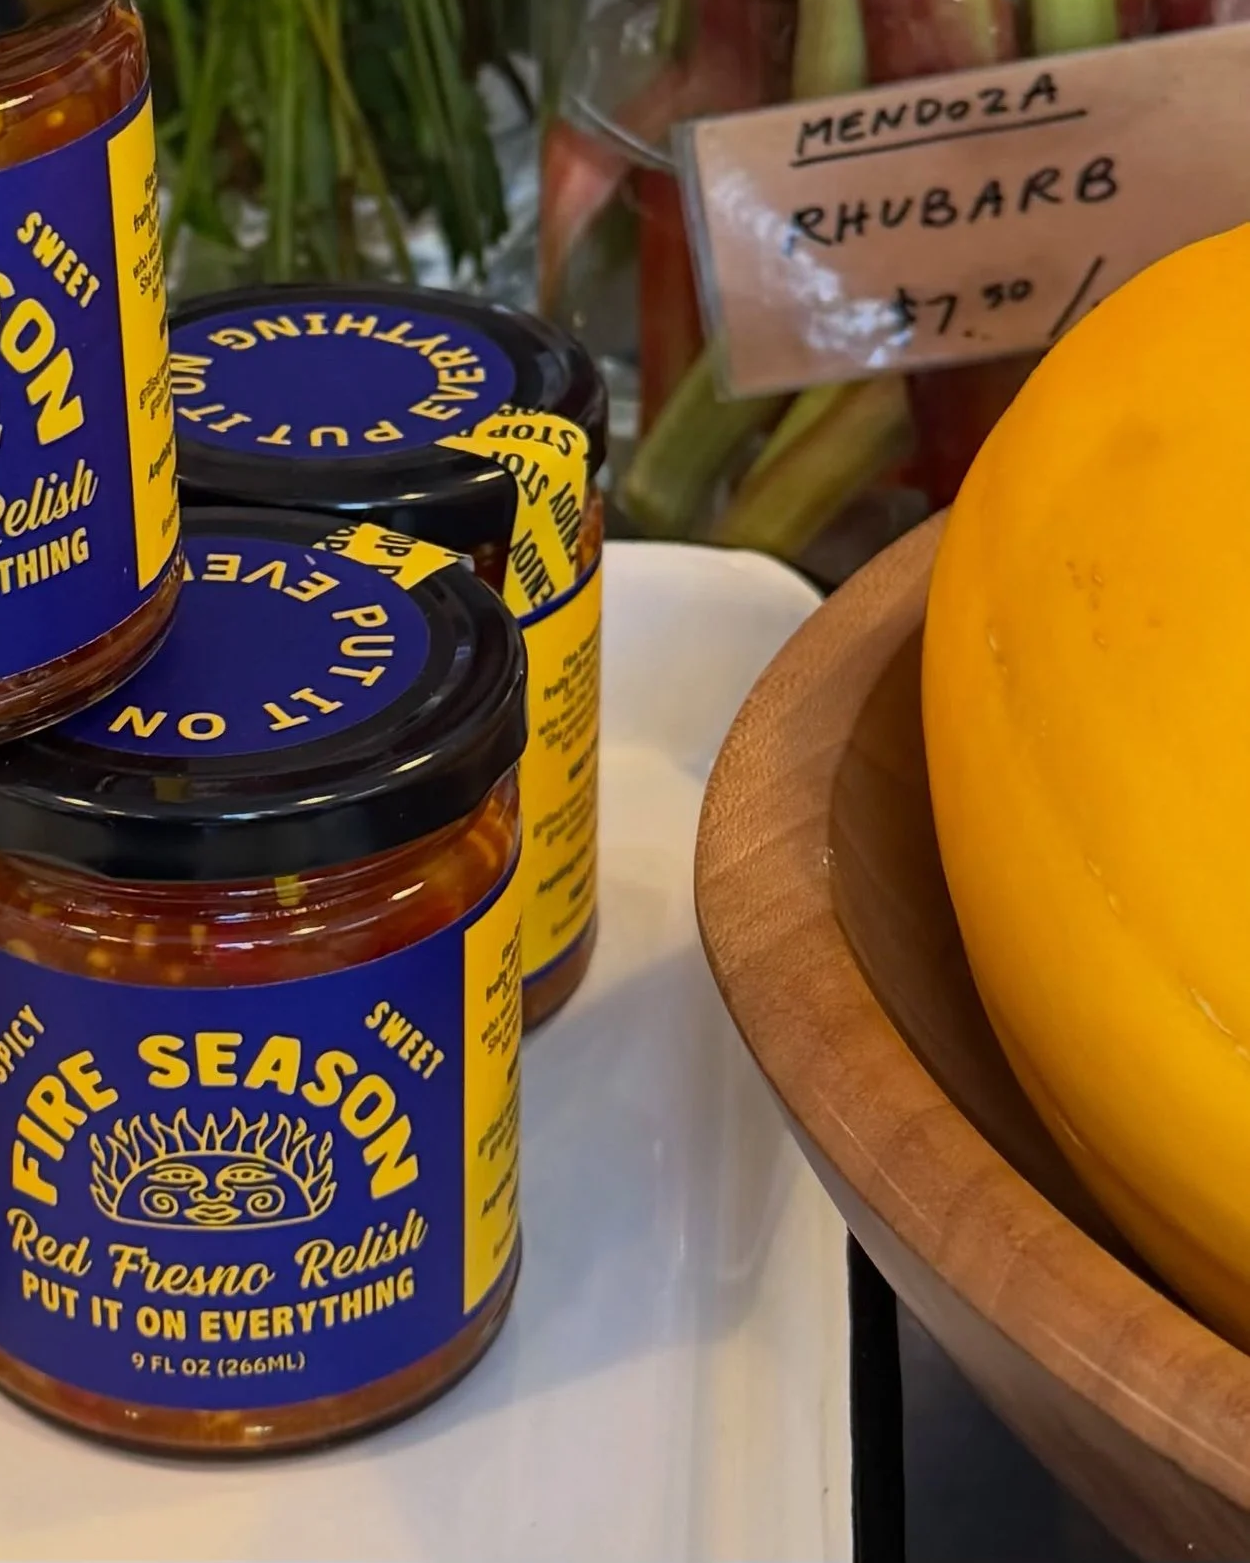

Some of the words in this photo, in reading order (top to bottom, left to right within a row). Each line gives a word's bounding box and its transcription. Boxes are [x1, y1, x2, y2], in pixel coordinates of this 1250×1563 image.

[783, 155, 1120, 258] RHUBARB
[16, 210, 101, 308] SWEET
[207, 312, 488, 422] EVERYTHING
[177, 402, 253, 434] IT
[256, 420, 405, 448] PUT
[330, 604, 397, 688] PUT
[107, 704, 228, 742] ON
[261, 685, 345, 734] IT
[363, 999, 447, 1080] SWEET
[11, 1049, 120, 1207] FIRE
[136, 1031, 421, 1200] SEASON
[6, 1207, 92, 1277] Red
[107, 1241, 276, 1297] Fresno
[292, 1207, 429, 1289] Relish
[21, 1268, 80, 1319] PUT
[90, 1297, 124, 1332] IT
[136, 1307, 187, 1340] ON
[200, 1266, 416, 1343] EVERYTHING
[131, 1352, 145, 1372] 9
[150, 1354, 176, 1376] FL
[181, 1355, 211, 1377] OZ
[217, 1350, 307, 1378] (266ML)
